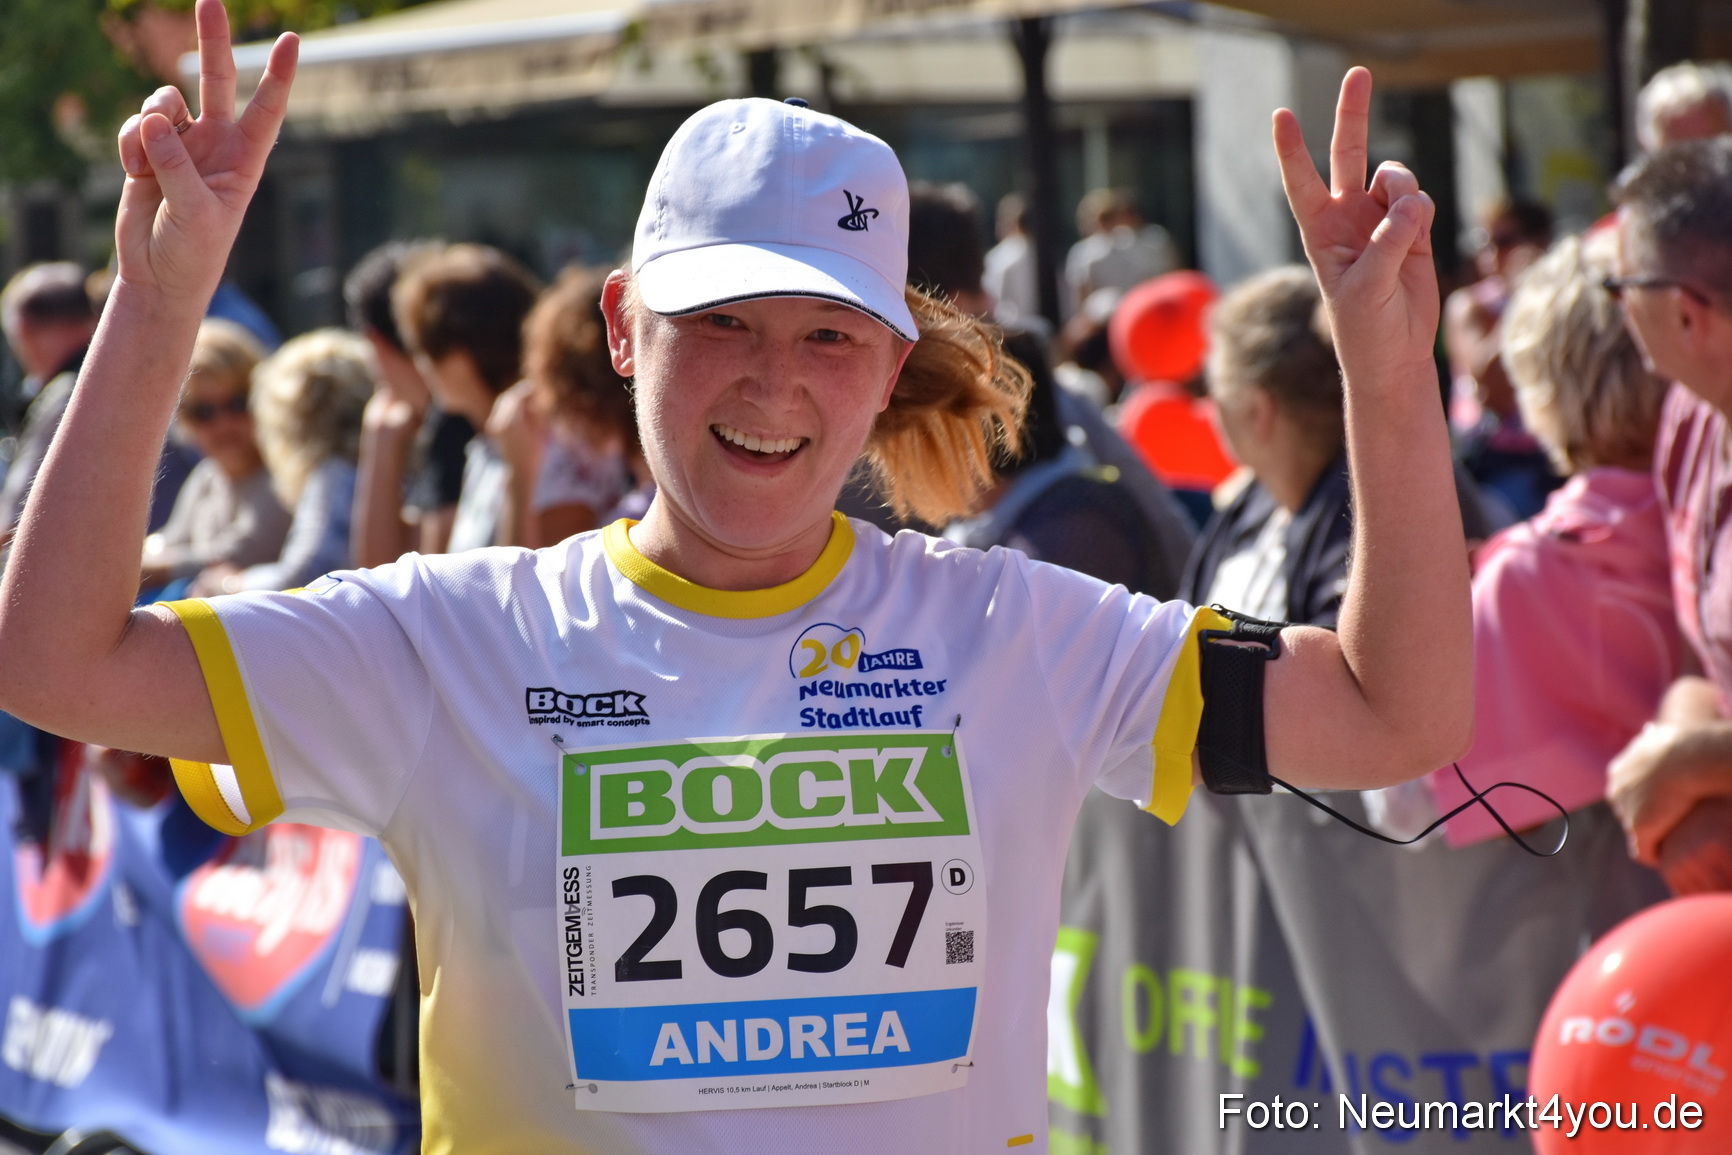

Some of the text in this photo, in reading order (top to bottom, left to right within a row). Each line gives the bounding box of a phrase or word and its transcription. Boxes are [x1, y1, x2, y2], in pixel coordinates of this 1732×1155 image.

[800, 633, 917, 678] 20 JAHRE
[526, 687, 649, 717] BOCK
[799, 678, 947, 701] Neumarkter
[528, 715, 650, 727] inspired by smart concepts
[799, 704, 923, 729] Stadtlauf
[594, 751, 934, 835] BOCK
[949, 867, 966, 886] D
[585, 865, 597, 996] TRANSPONDER ZEITMESSUNG
[611, 861, 934, 982] 2657
[649, 1010, 911, 1066] ANDREA
[698, 1087, 725, 1095] HERVIS
[726, 1086, 740, 1094] 10,5
[741, 1085, 752, 1093] km
[771, 1084, 793, 1093] Appelt,
[795, 1082, 818, 1090] Andrea
[822, 1080, 853, 1089] Startblock
